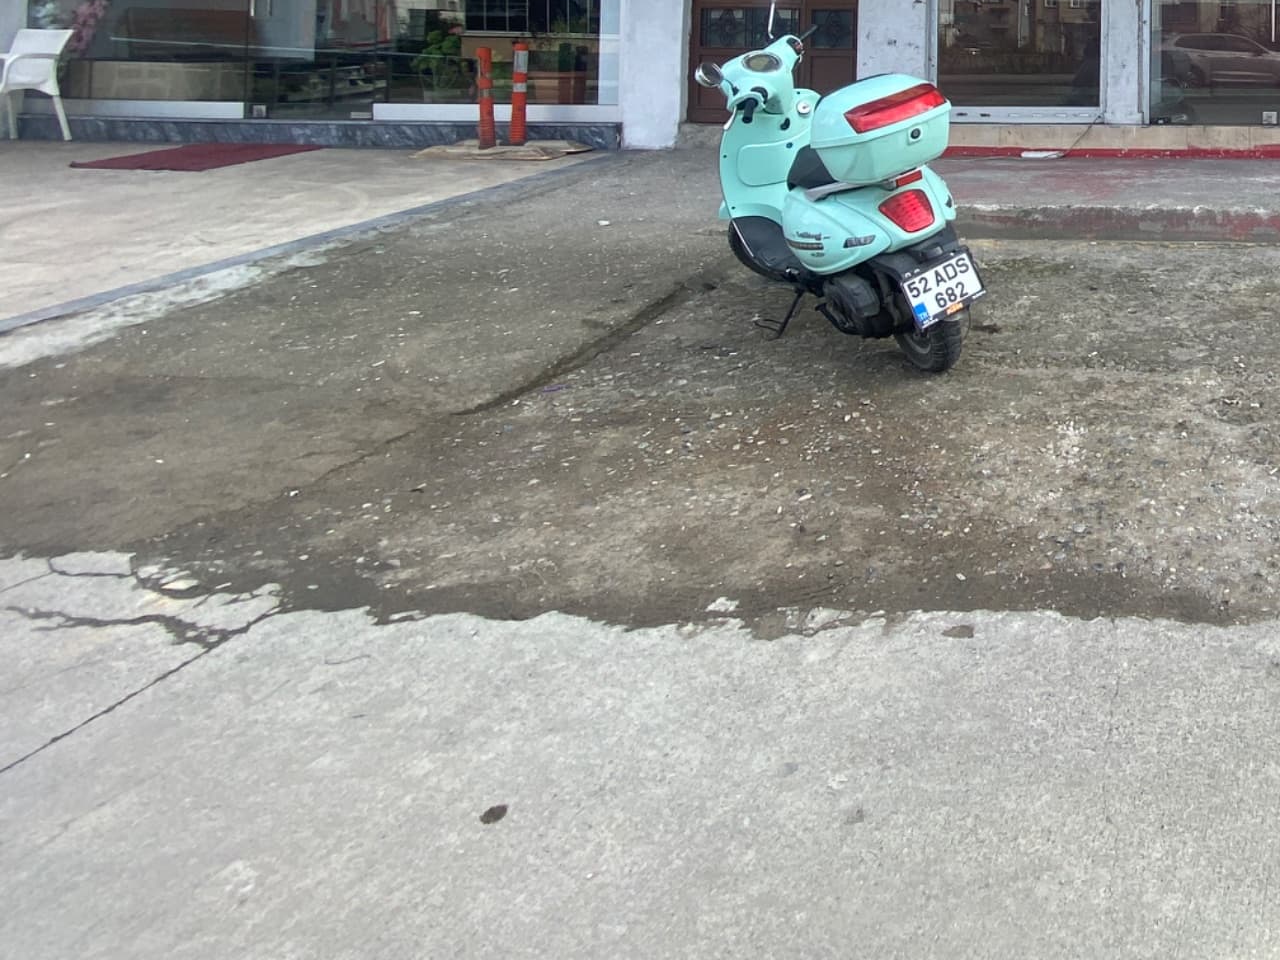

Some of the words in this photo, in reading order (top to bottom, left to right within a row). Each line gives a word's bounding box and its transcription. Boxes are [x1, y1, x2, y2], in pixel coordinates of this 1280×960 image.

[907, 276, 932, 298] 52
[933, 257, 969, 287] ADS
[934, 281, 969, 308] 682
